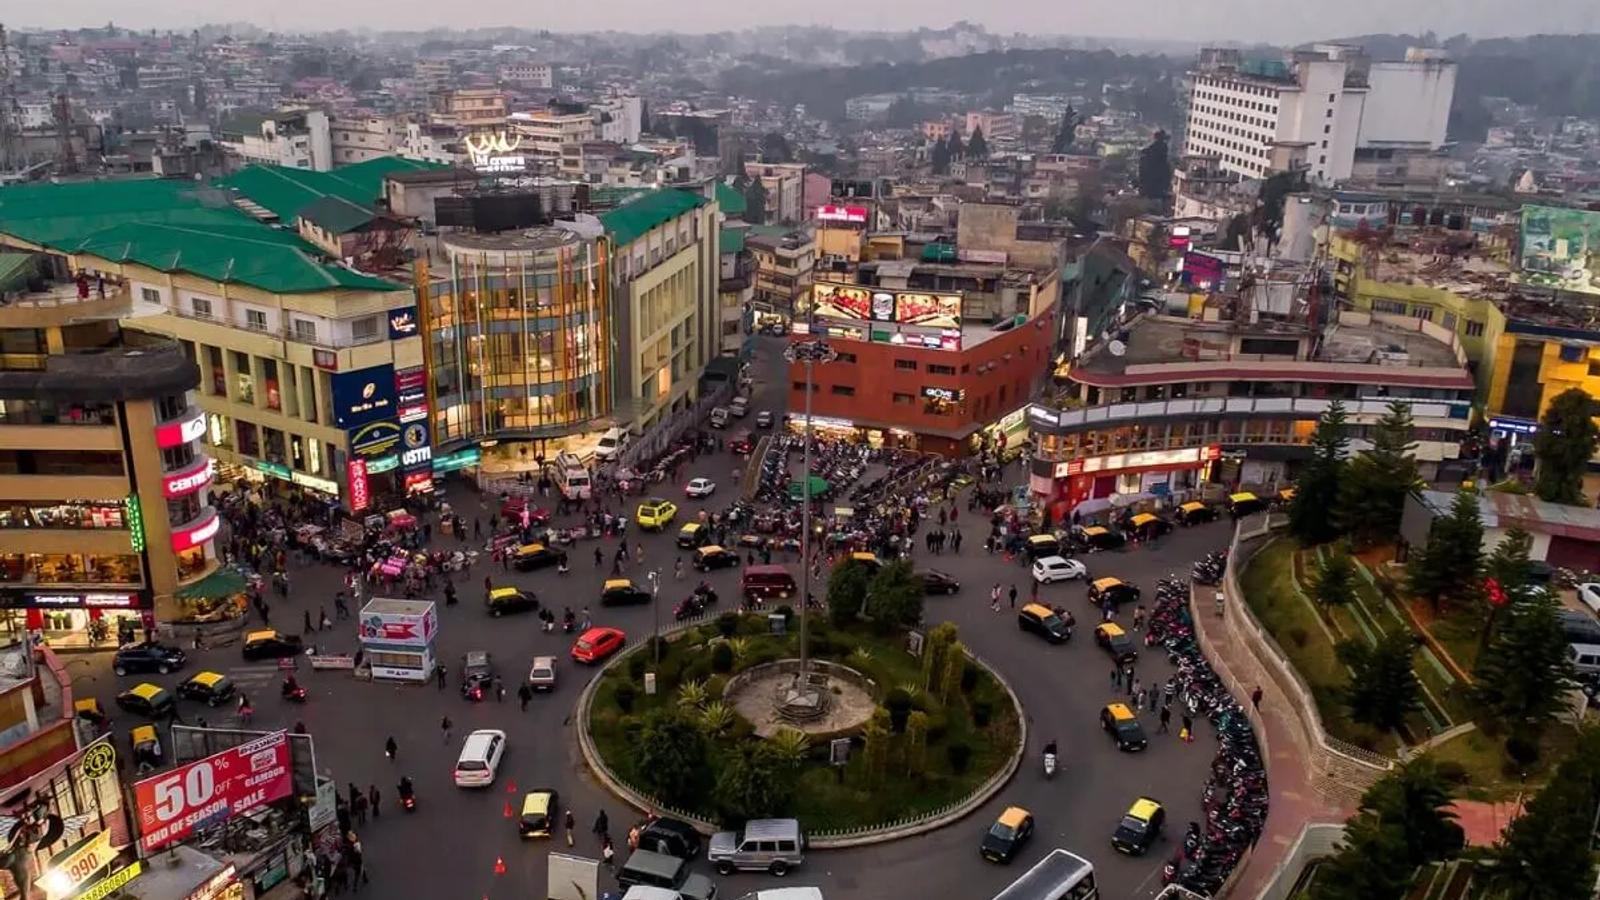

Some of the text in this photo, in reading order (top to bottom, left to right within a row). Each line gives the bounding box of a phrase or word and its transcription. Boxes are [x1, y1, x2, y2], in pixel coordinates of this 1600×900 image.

[214, 778, 232, 796] OFF
[145, 788, 267, 848] END OF SEASON SALE
